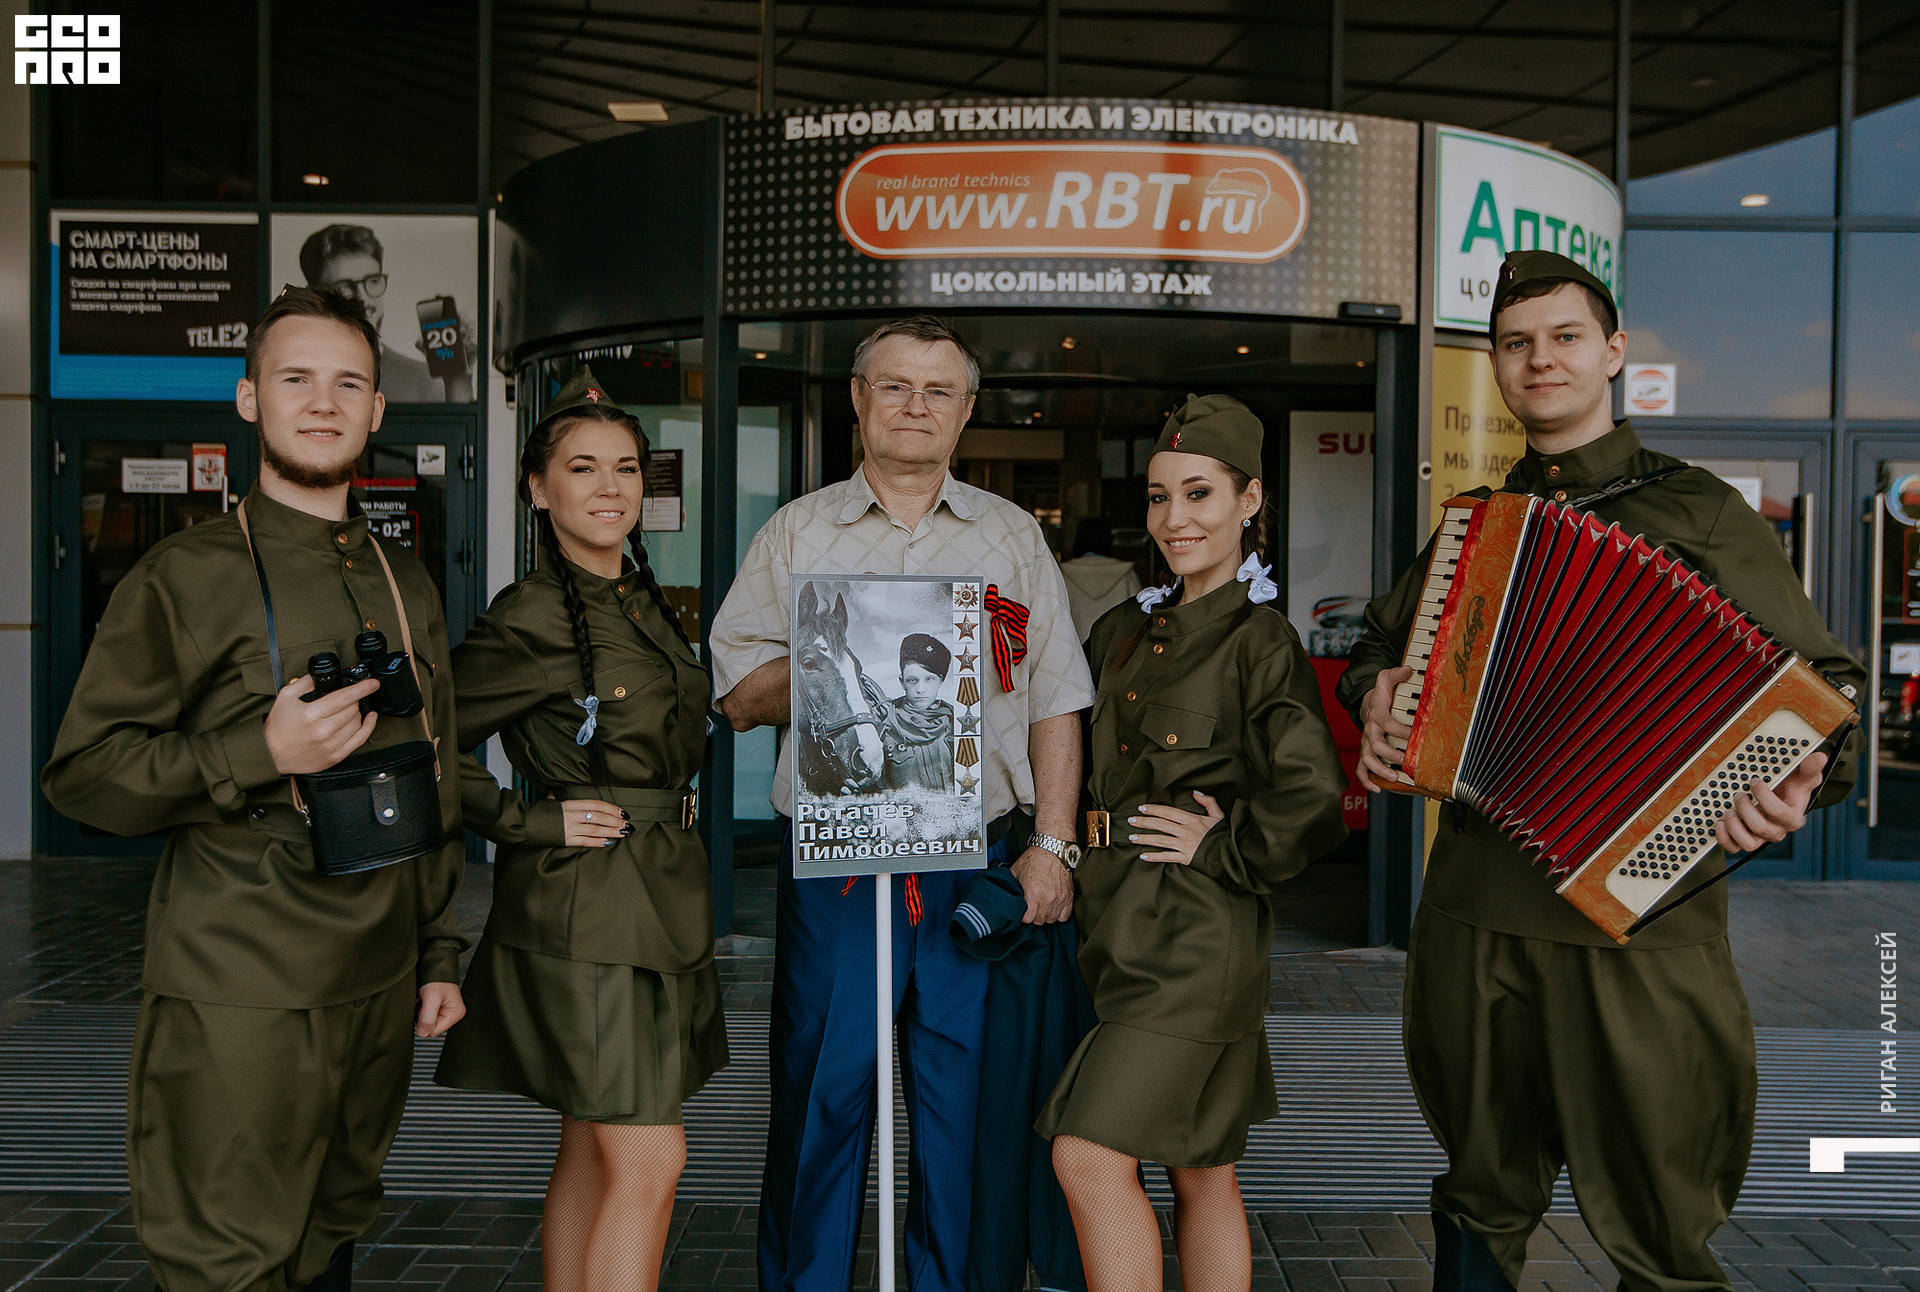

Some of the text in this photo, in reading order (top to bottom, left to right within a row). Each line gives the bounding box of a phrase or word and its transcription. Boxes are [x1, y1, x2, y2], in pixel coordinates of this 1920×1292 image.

[785, 105, 1359, 145] БЫТОВАЯ ТЕХНИКА И ЭЛЕКТРОНИКА
[876, 172, 1031, 190] real brand technics
[875, 171, 1256, 235] www.RBT.ru
[69, 230, 200, 252] СМАРТ-ЦЕНЫ
[1461, 181, 1613, 291] Аптека
[69, 251, 228, 271] НА СМАРТФОНЫ
[931, 267, 1213, 296] ЦОКОЛЬНЫЙ ЭТАЖ
[187, 321, 248, 348] TELE2
[427, 326, 457, 349] 20
[1318, 433, 1374, 455] SU
[373, 501, 407, 511] РАБОТЫ
[799, 822, 888, 841] Павел
[799, 838, 980, 861] Тимофеевич
